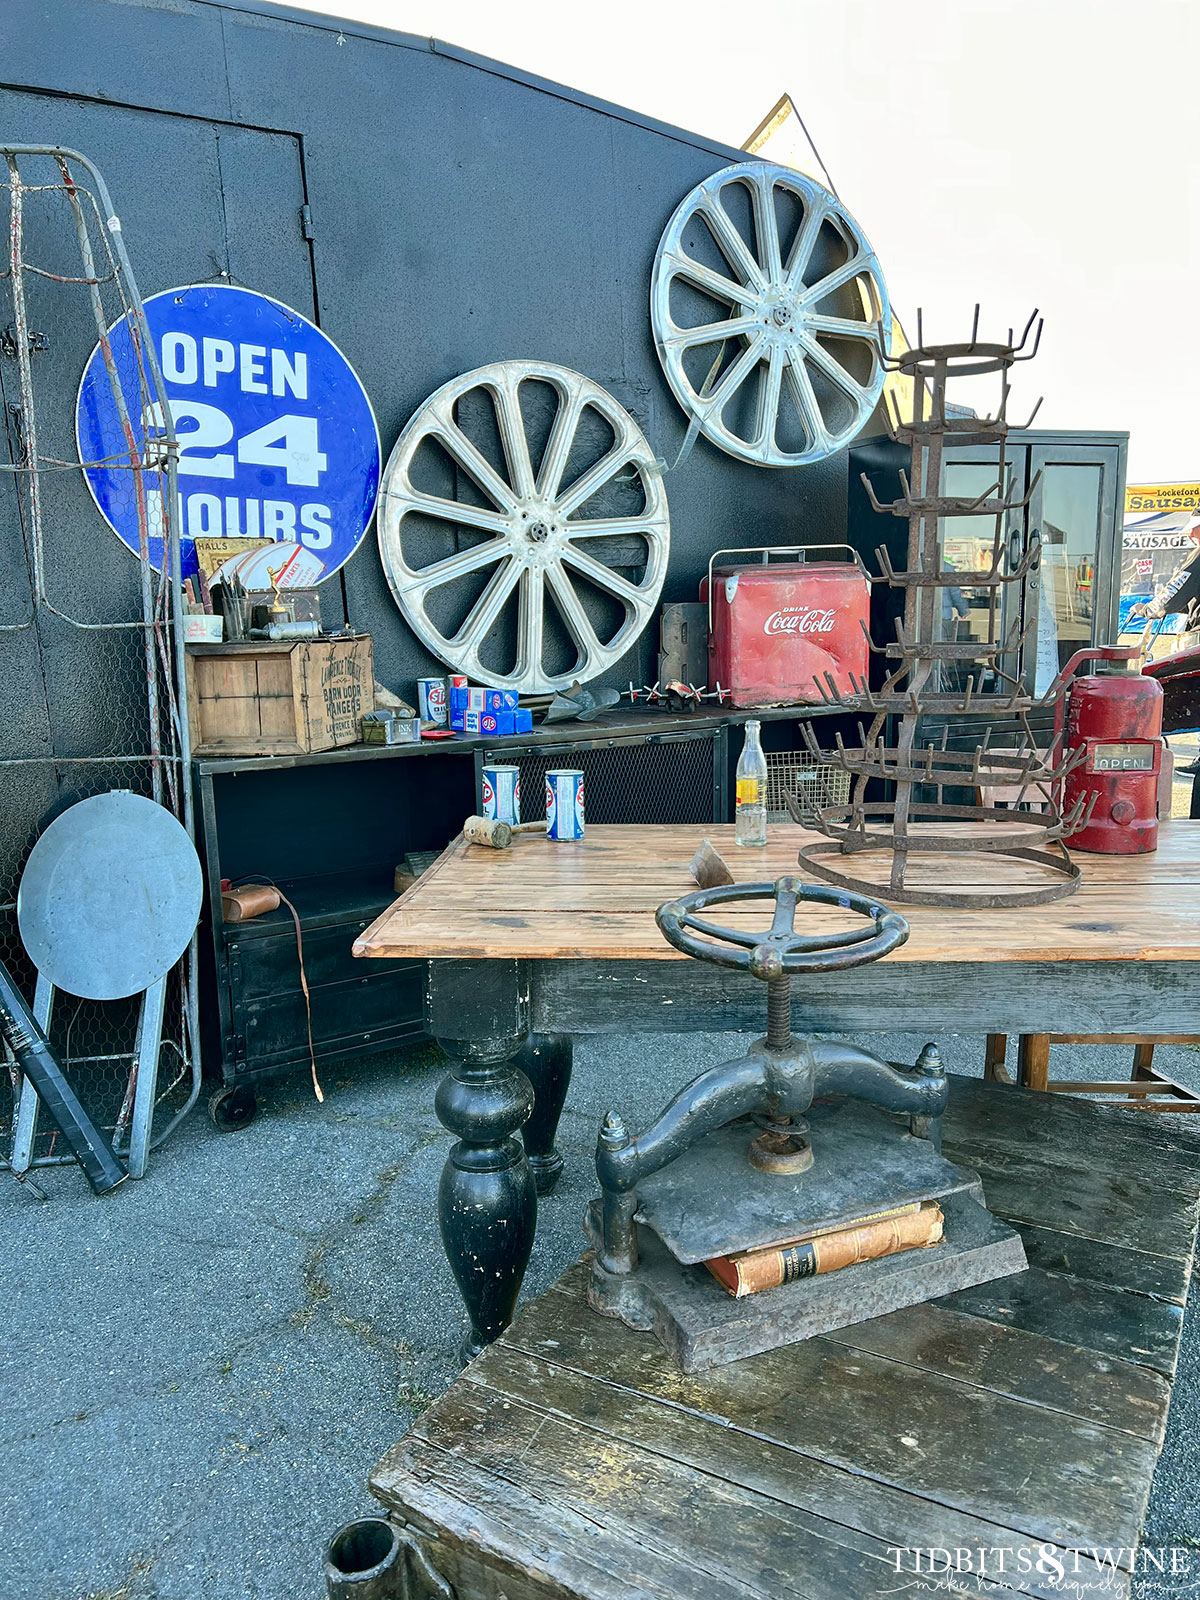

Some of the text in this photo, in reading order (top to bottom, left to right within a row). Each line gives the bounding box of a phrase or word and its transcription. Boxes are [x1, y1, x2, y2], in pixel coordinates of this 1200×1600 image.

[161, 332, 307, 400] OPEN
[140, 400, 327, 487] 24
[1157, 487, 1199, 497] Lockeford
[146, 490, 332, 549] HOURS
[198, 542, 228, 551] HALL'S
[1122, 535, 1187, 548] SAUSAGE
[286, 562, 300, 579] PARTS
[764, 609, 836, 635] Coca-Cola
[323, 684, 361, 703] BARN DOOR
[326, 699, 361, 717] HANGERS
[398, 724, 412, 733] INK
[483, 718, 495, 730] STP
